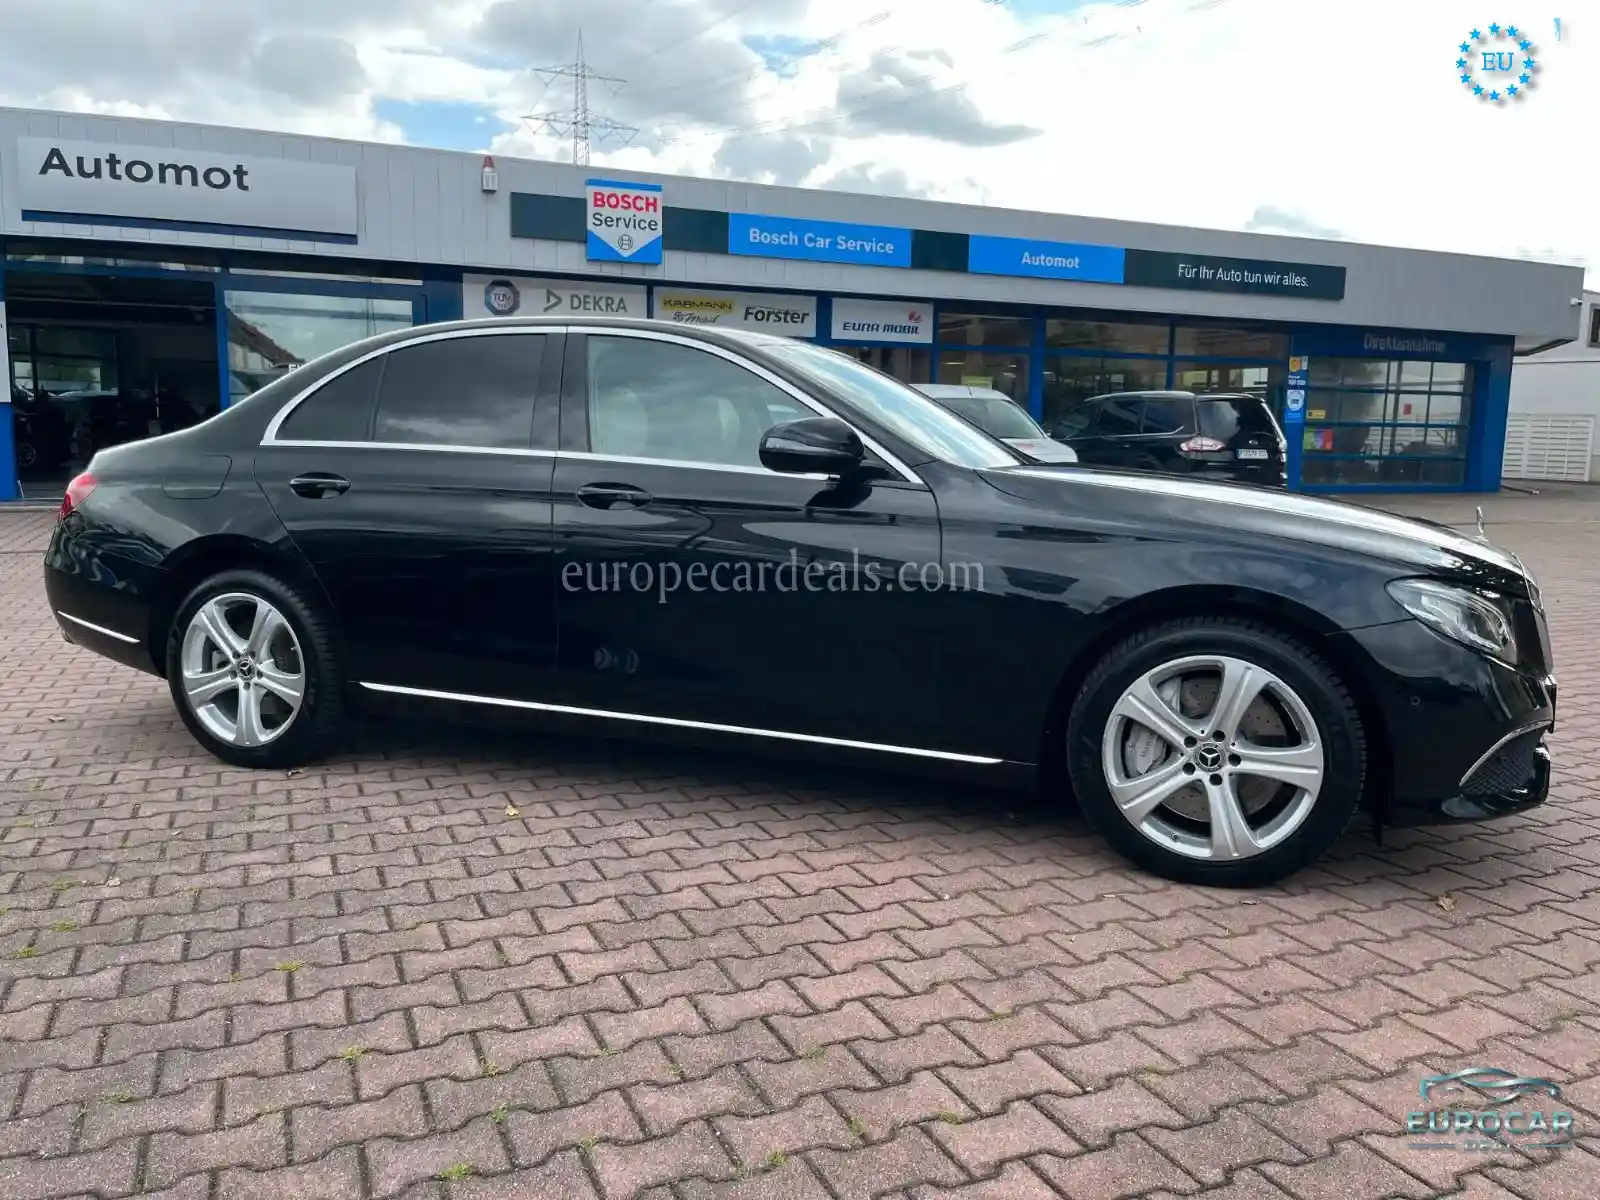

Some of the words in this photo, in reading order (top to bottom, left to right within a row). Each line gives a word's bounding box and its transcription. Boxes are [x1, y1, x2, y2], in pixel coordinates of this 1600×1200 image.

[38, 147, 249, 191] Automot
[593, 191, 658, 213] BOSCH
[592, 212, 659, 231] Service
[749, 227, 798, 246] Bosch
[804, 232, 833, 249] Car
[837, 235, 894, 254] Service
[1021, 251, 1080, 269] Automot
[1178, 264, 1197, 278] Für
[1199, 265, 1215, 280] Ihr
[1216, 267, 1242, 282] Auto
[1244, 270, 1262, 284] tun
[1264, 271, 1281, 285] wir
[1282, 272, 1309, 287] alles.
[570, 293, 628, 313] DEKRA
